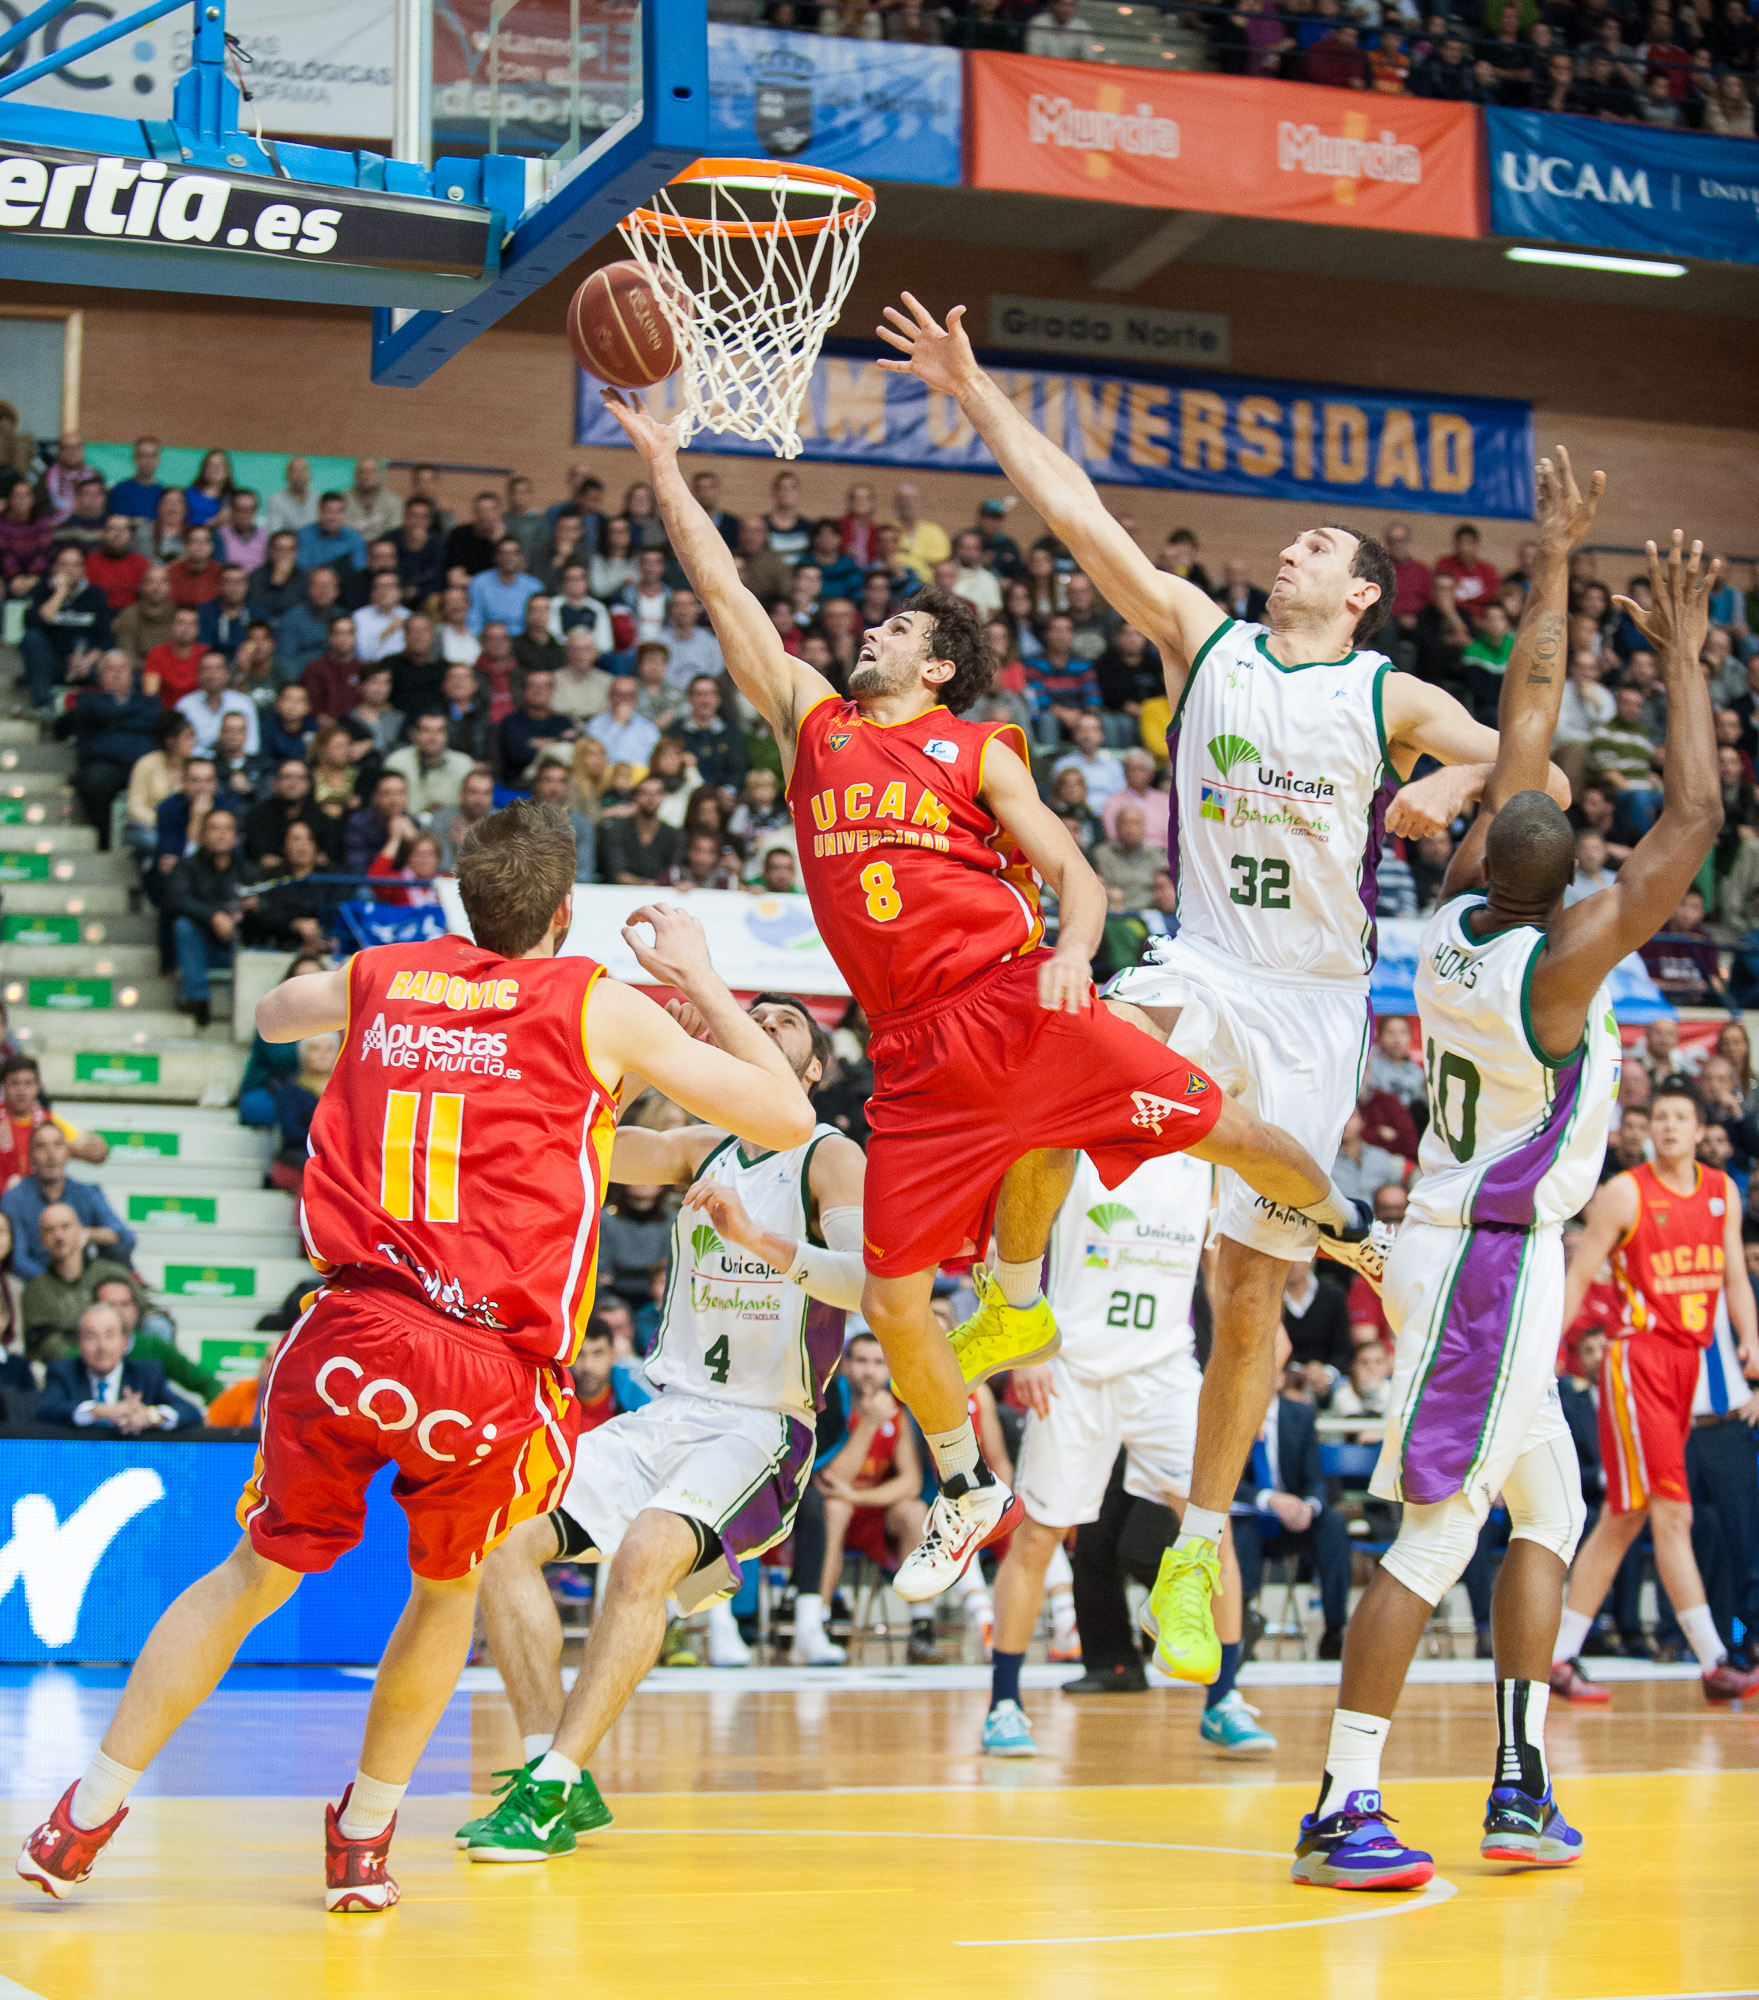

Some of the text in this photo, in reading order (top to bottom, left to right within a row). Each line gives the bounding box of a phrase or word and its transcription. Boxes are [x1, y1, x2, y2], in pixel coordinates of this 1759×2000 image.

[1029, 94, 1180, 159] Murcia
[1278, 121, 1422, 184] Murcia
[1500, 151, 1654, 209] UCAM
[810, 781, 952, 835] UCAM
[1257, 766, 1336, 799] Unicaja
[813, 829, 950, 858] UNIVERSIDAD
[860, 861, 903, 923] 8
[1229, 854, 1291, 910] 32
[386, 970, 519, 1011] RADOVIC
[360, 1012, 508, 1067] Apuestas
[389, 1046, 418, 1069] de
[380, 1088, 466, 1224] 11
[1136, 1223, 1196, 1248] Unicaja
[1106, 1290, 1157, 1331] 20
[703, 1333, 731, 1385] 4
